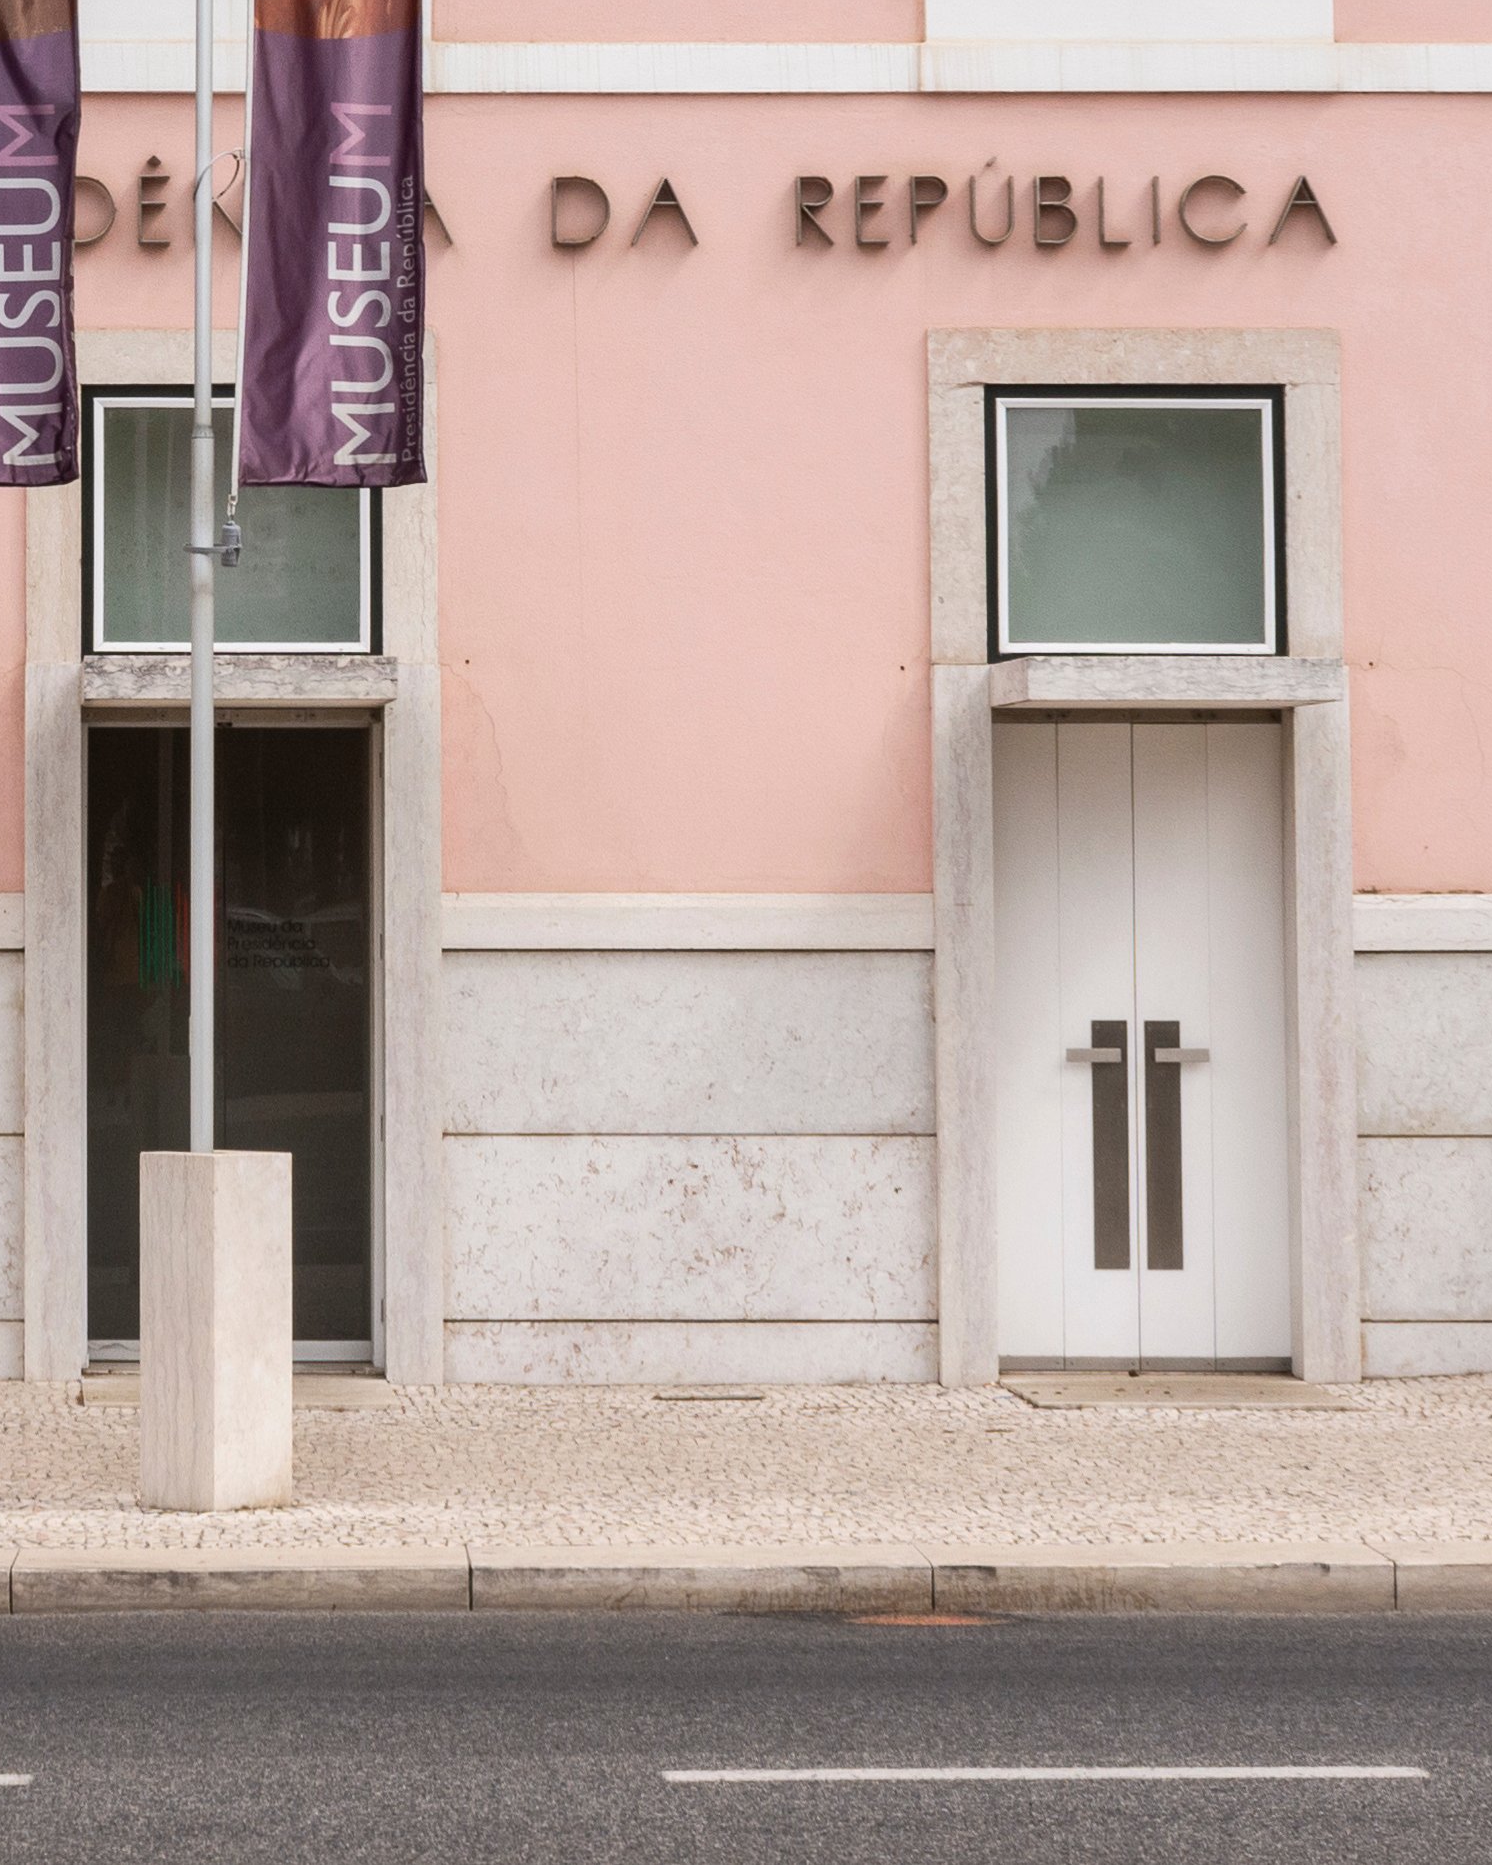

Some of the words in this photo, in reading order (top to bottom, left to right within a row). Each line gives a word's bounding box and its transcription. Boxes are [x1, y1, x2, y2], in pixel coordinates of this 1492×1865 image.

[395, 174, 416, 289] República
[551, 175, 699, 248] DA
[795, 156, 1338, 248] REPÚBLICA
[327, 102, 397, 466] MUSEUM
[396, 295, 416, 323] da
[392, 332, 417, 463] Presidência
